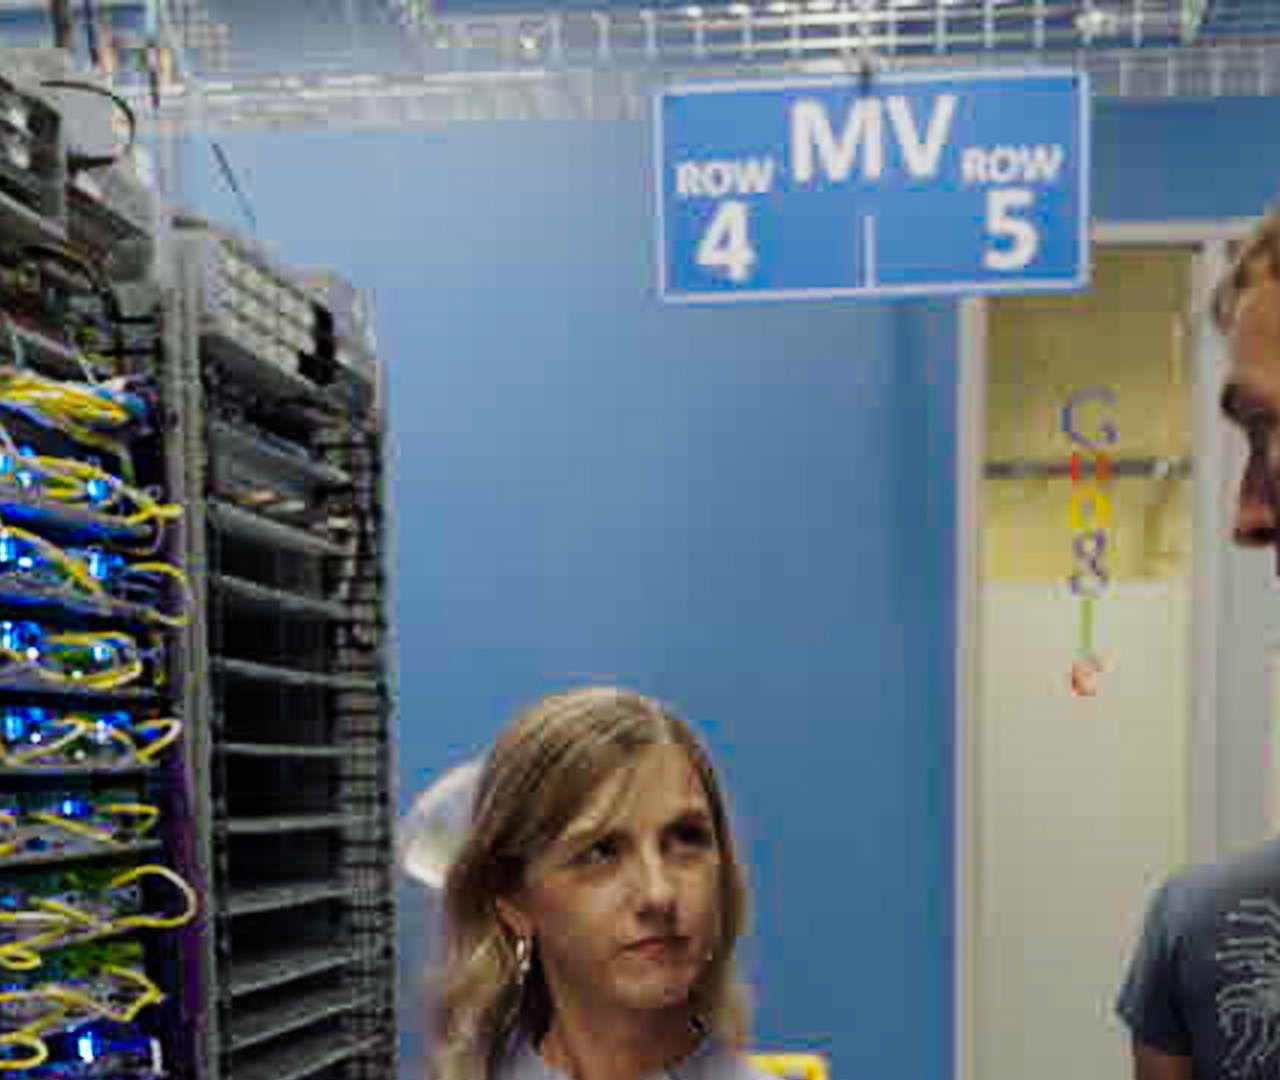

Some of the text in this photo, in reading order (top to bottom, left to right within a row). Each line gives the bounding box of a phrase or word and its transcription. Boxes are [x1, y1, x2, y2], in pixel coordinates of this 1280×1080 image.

[676, 159, 774, 195] ROW
[790, 94, 958, 184] MV
[962, 145, 1064, 182] ROW
[694, 200, 756, 283] 4
[982, 188, 1040, 270] 5
